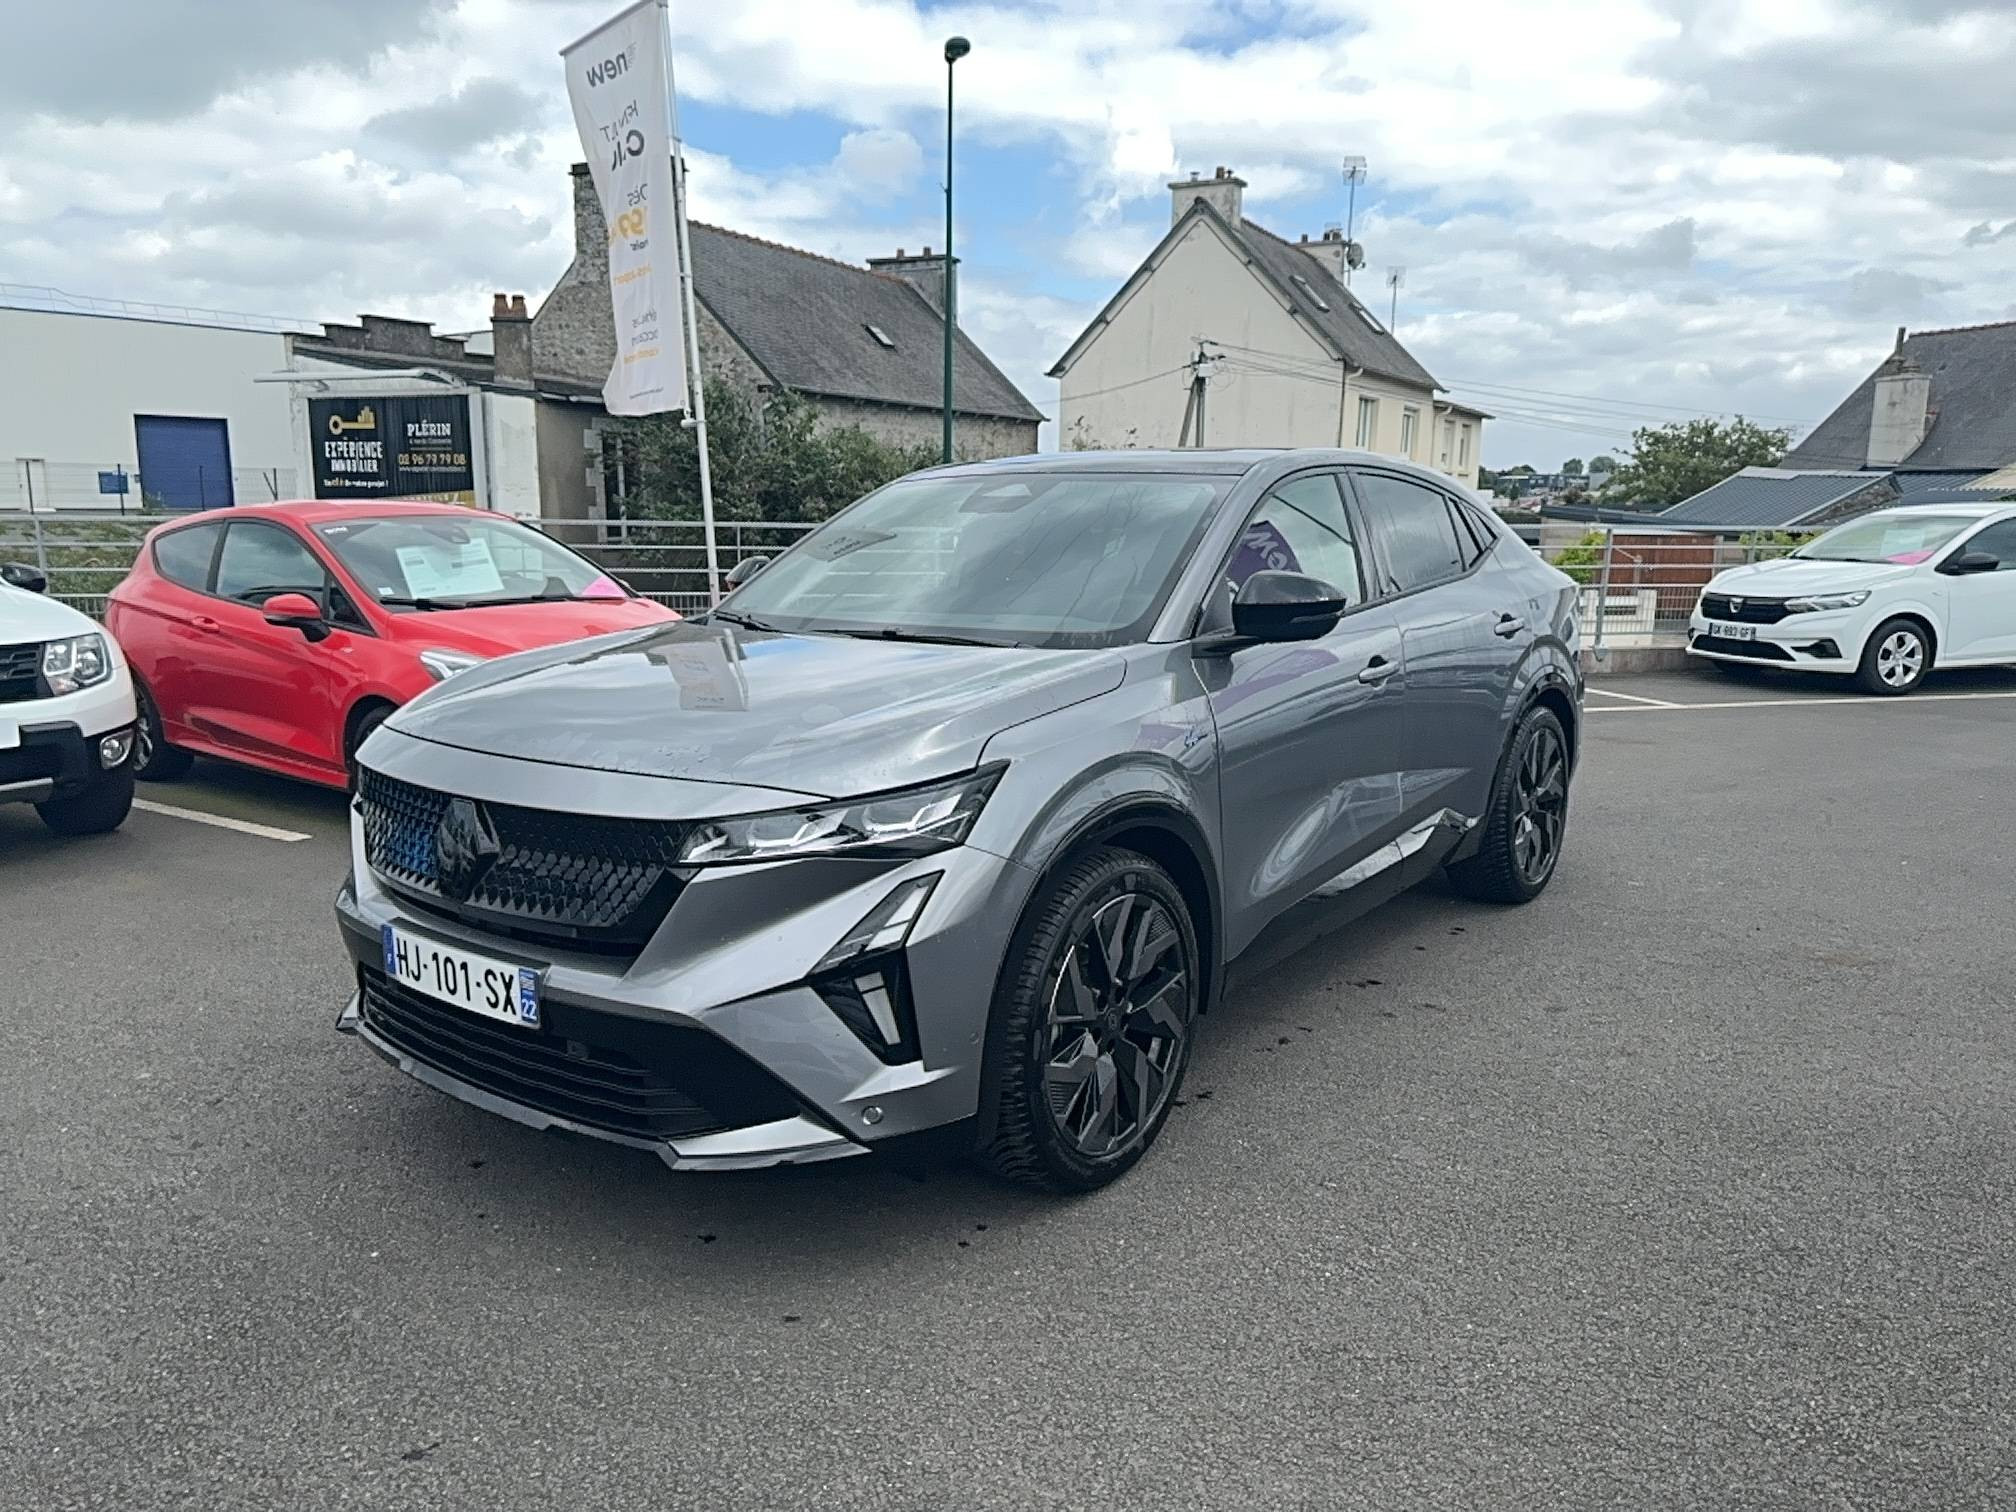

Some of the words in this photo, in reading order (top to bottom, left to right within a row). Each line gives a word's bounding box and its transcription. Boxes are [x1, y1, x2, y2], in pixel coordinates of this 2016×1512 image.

[407, 419, 452, 437] PLÉRIN
[324, 436, 384, 459] EXPÉRIENCE
[398, 453, 410, 466] 02
[412, 453, 425, 466] 96
[521, 998, 537, 1019] 22
